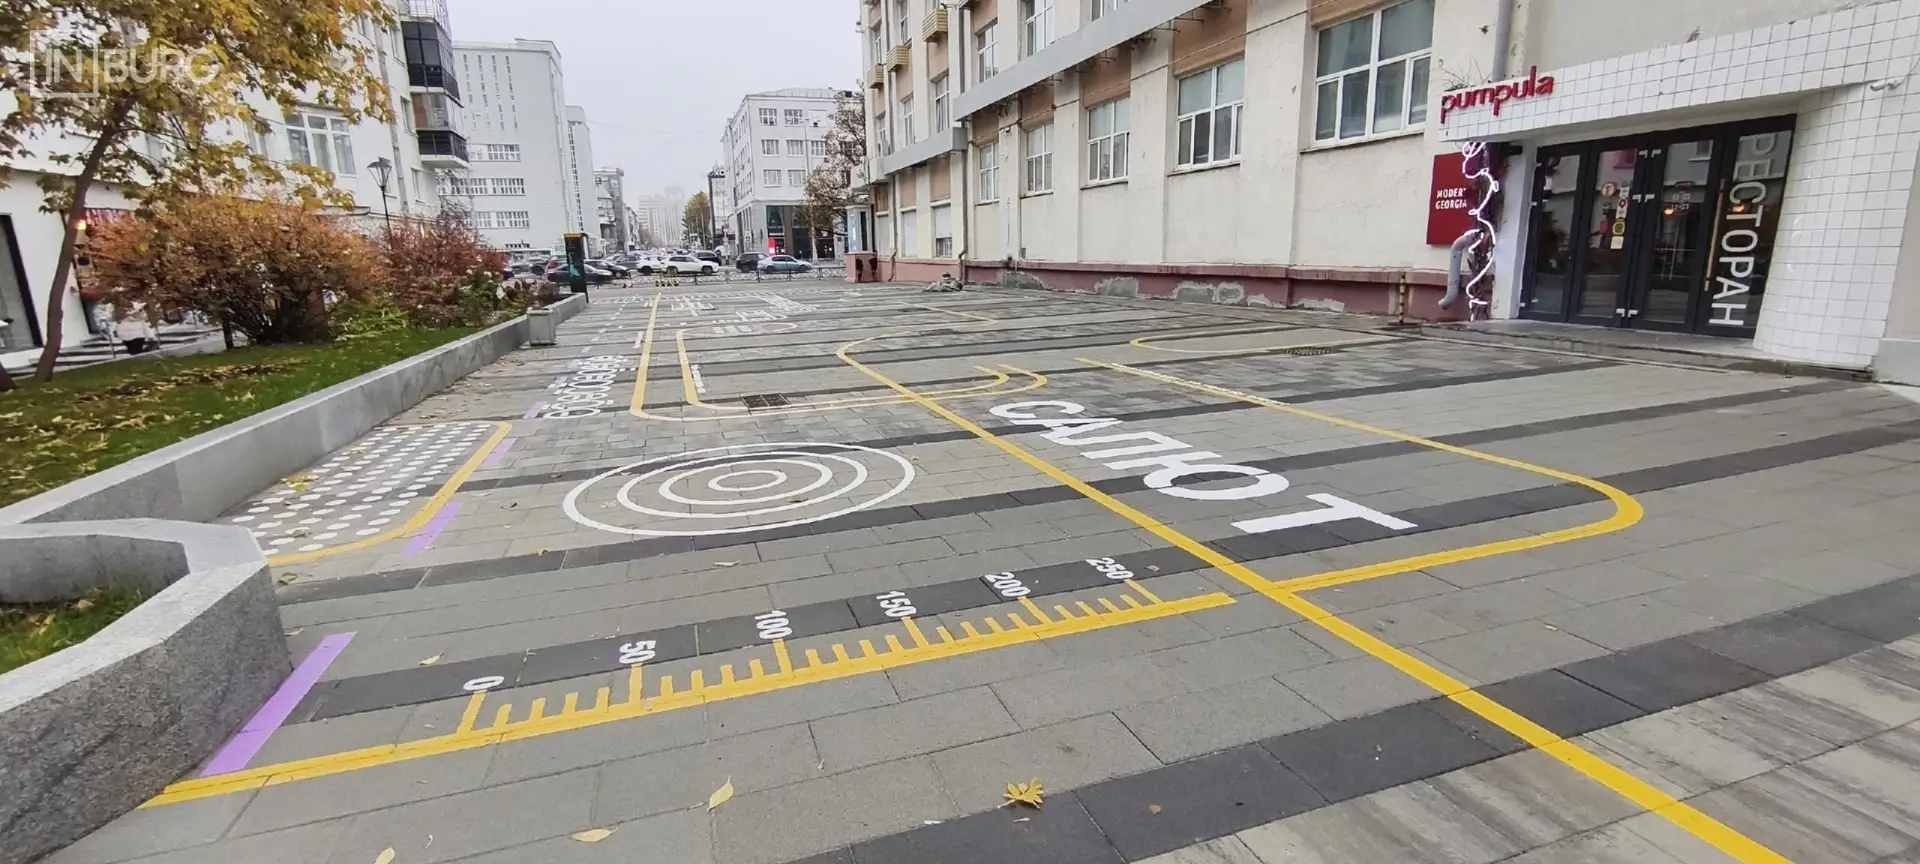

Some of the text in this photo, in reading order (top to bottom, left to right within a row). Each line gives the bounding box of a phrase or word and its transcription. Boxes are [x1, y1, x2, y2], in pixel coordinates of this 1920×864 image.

[1440, 65, 1555, 124] pumpula
[1435, 199, 1467, 210] GEORGIA
[1436, 187, 1467, 199] MODER
[1708, 133, 1777, 326] РЕСТОРАН
[989, 400, 1419, 534] САЛЮТ
[1085, 556, 1136, 580] 250
[984, 571, 1032, 598] 200
[875, 590, 918, 618] 150
[754, 609, 793, 640] 100
[619, 639, 657, 665] 50
[463, 675, 505, 692] 0
